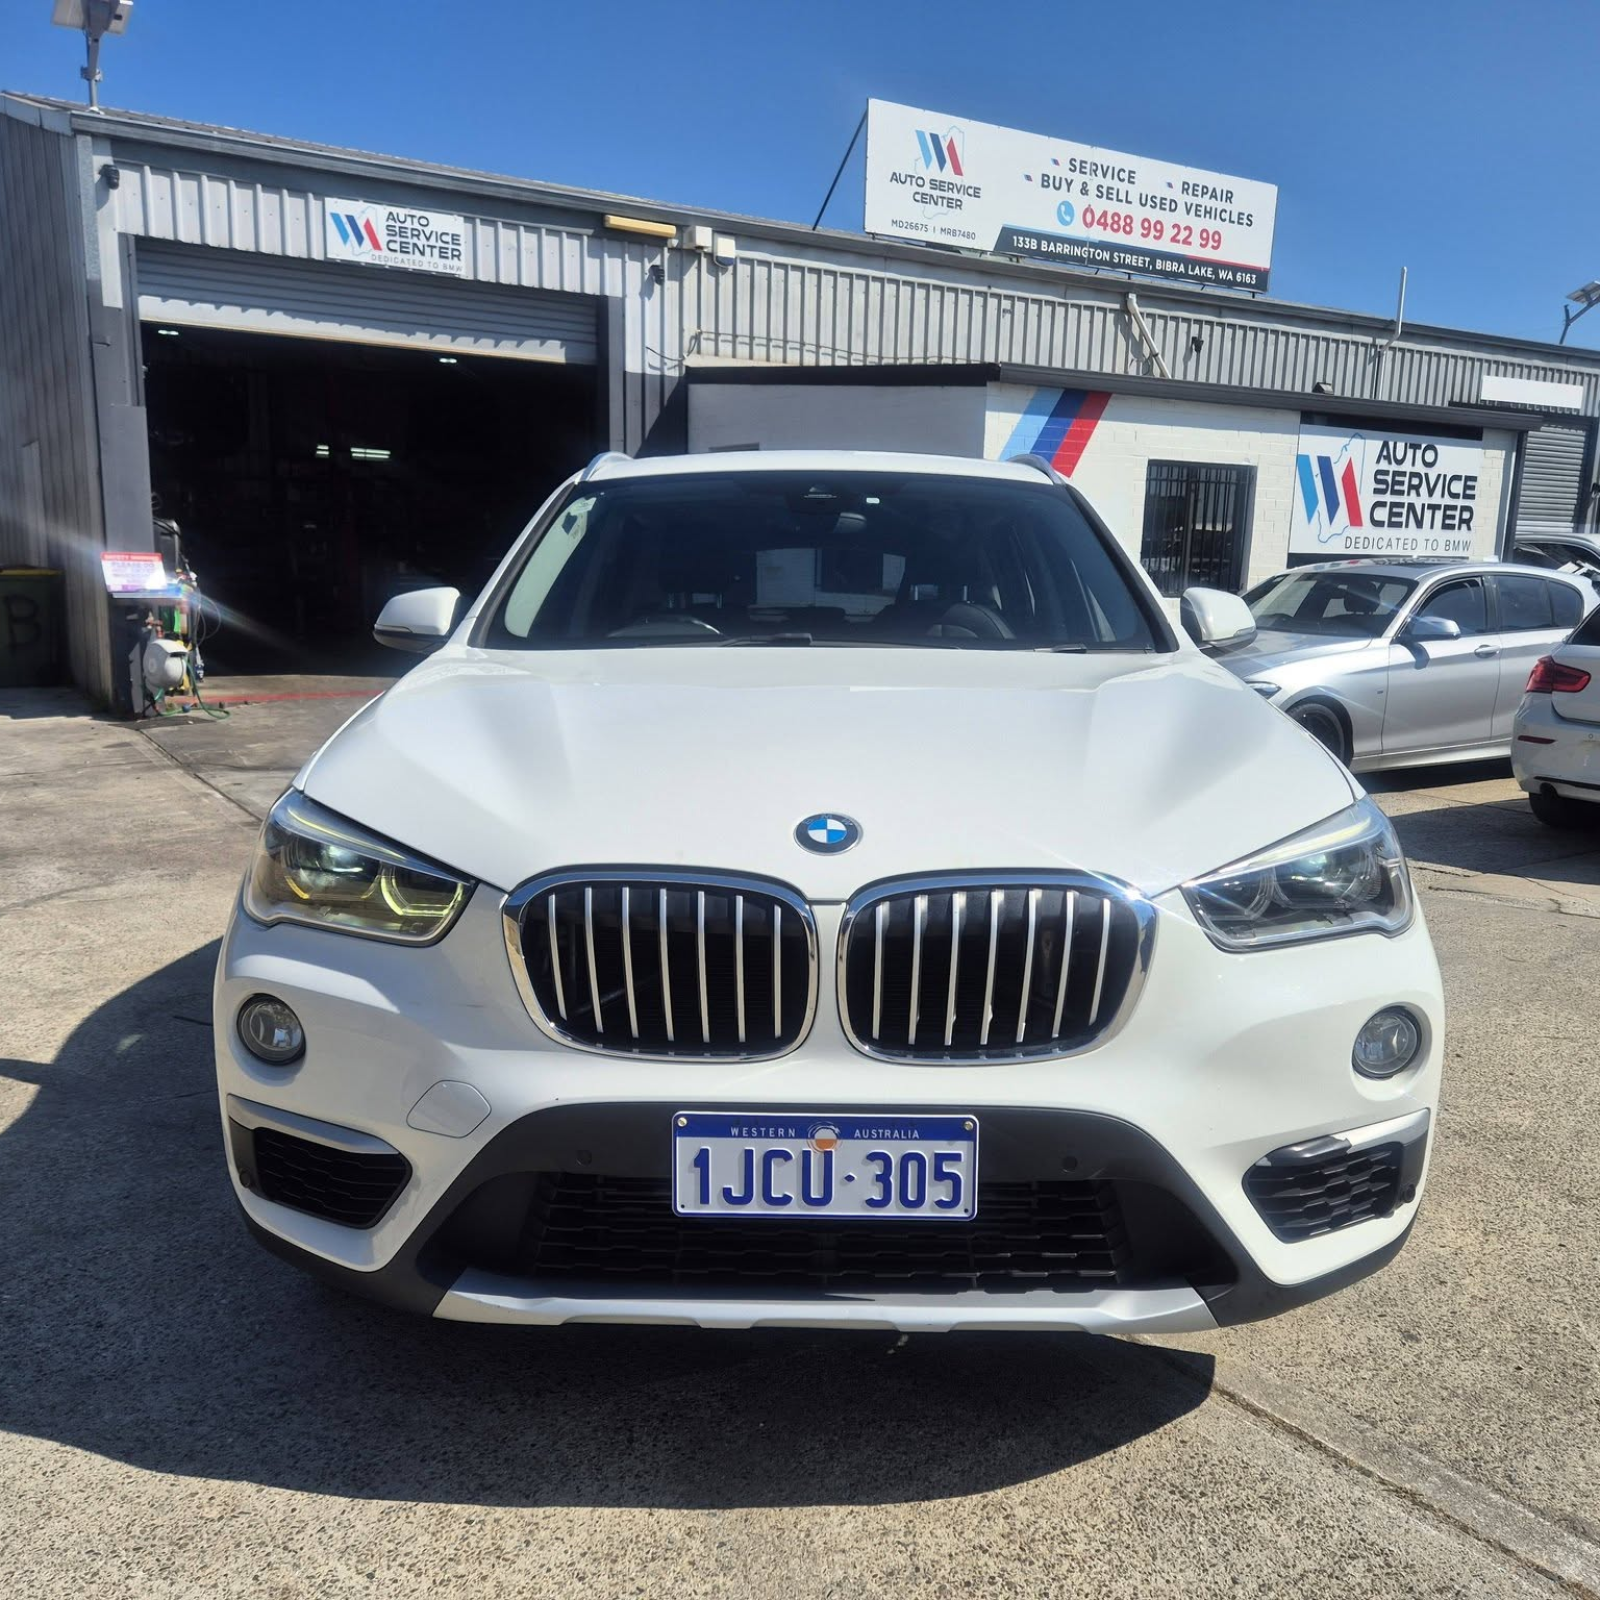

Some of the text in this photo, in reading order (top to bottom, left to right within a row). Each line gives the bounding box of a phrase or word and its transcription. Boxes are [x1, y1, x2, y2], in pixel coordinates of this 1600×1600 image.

[889, 171, 982, 199] AUTO SERVICE
[1068, 157, 1234, 204] SERVICE REPAIR
[912, 191, 963, 210] CENTER
[1041, 173, 1254, 228] BUY & SELL USED VEHICLES
[385, 211, 430, 228] AUTO
[891, 219, 929, 233] MD26675
[940, 227, 976, 240] MRB7480
[1082, 206, 1222, 251] 0488 99 22 99
[385, 224, 462, 247] SERVICE
[371, 254, 463, 272] DEDICATED TO BMW
[386, 239, 462, 262] CENTER
[1012, 235, 1257, 284] 133B BARRINGTON STREET, BIBRA LAKE, WA 6163
[1376, 440, 1438, 468] AUTO
[1373, 469, 1477, 500] SERVICE
[1369, 501, 1474, 531] CENTER
[1345, 536, 1471, 552] DEDICATED TO BMW
[730, 1127, 920, 1140] WESTERN AUSTRALIA
